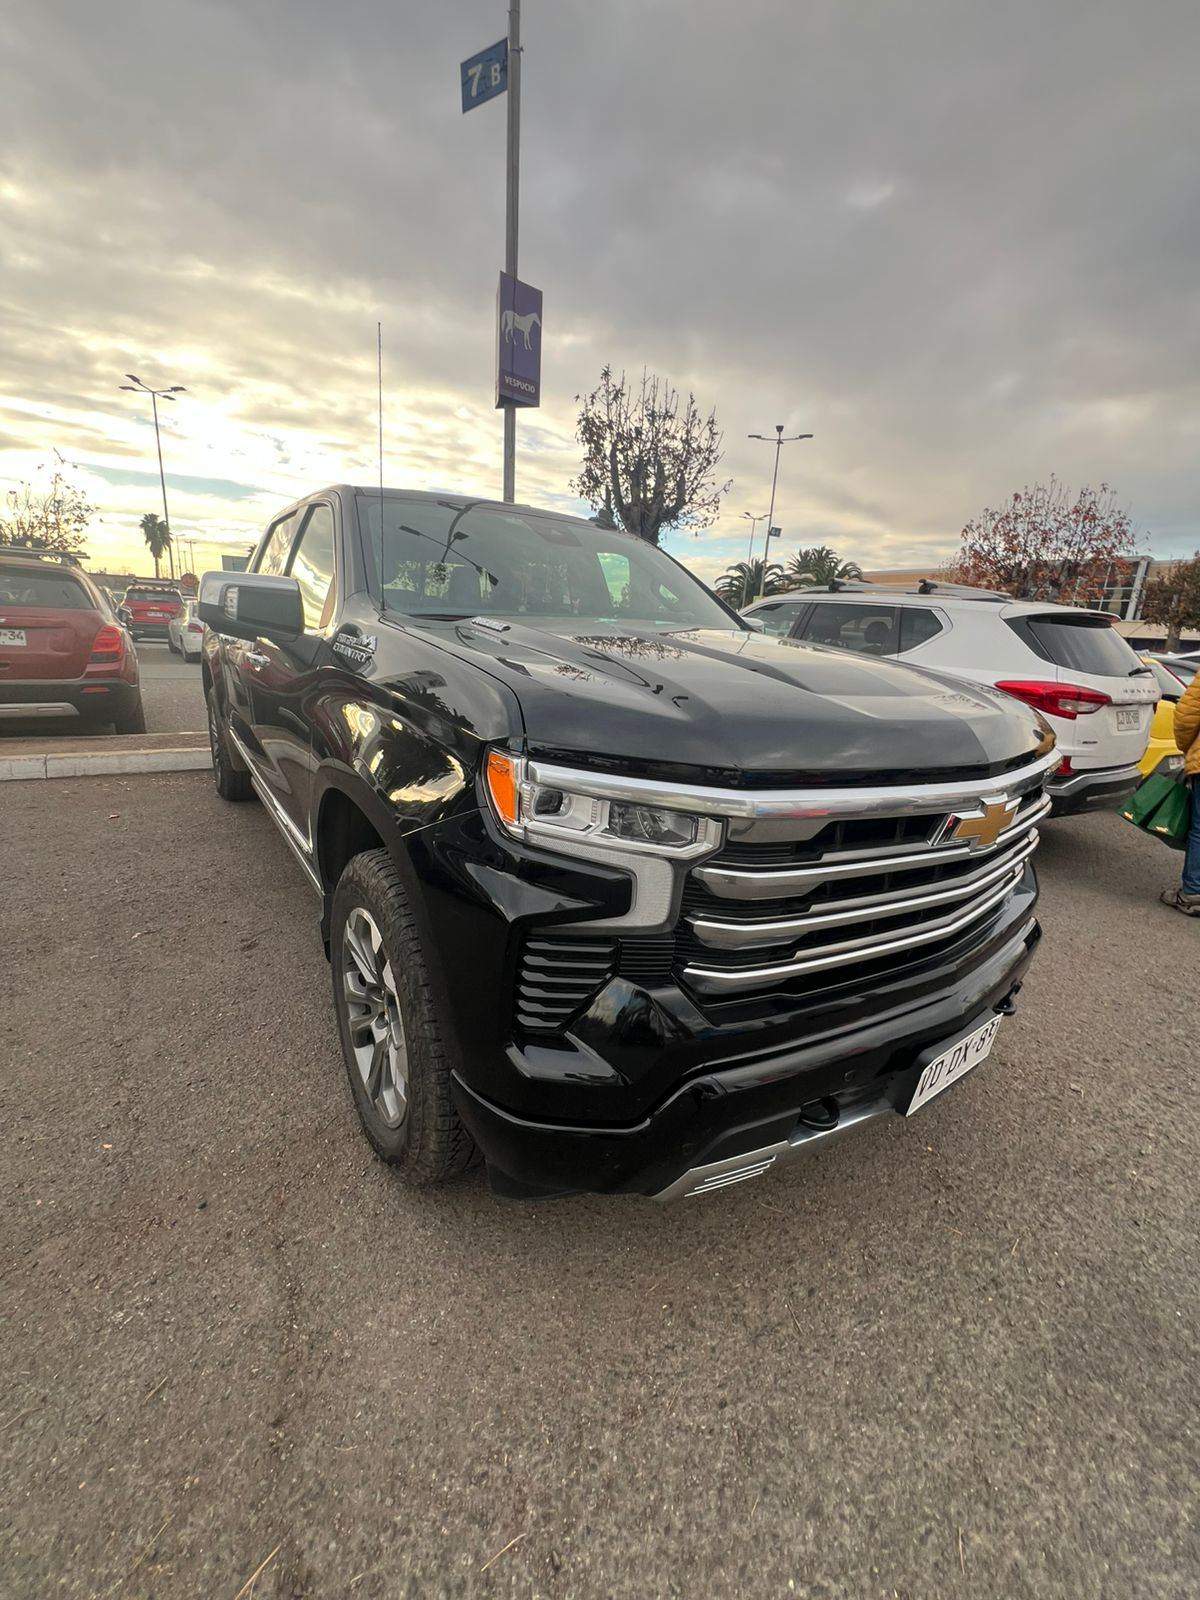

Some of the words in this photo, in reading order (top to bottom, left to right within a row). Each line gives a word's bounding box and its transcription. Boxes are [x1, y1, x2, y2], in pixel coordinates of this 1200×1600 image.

[468, 63, 483, 97] 7
[491, 63, 501, 87] B
[504, 375, 535, 393] VESPUCIO
